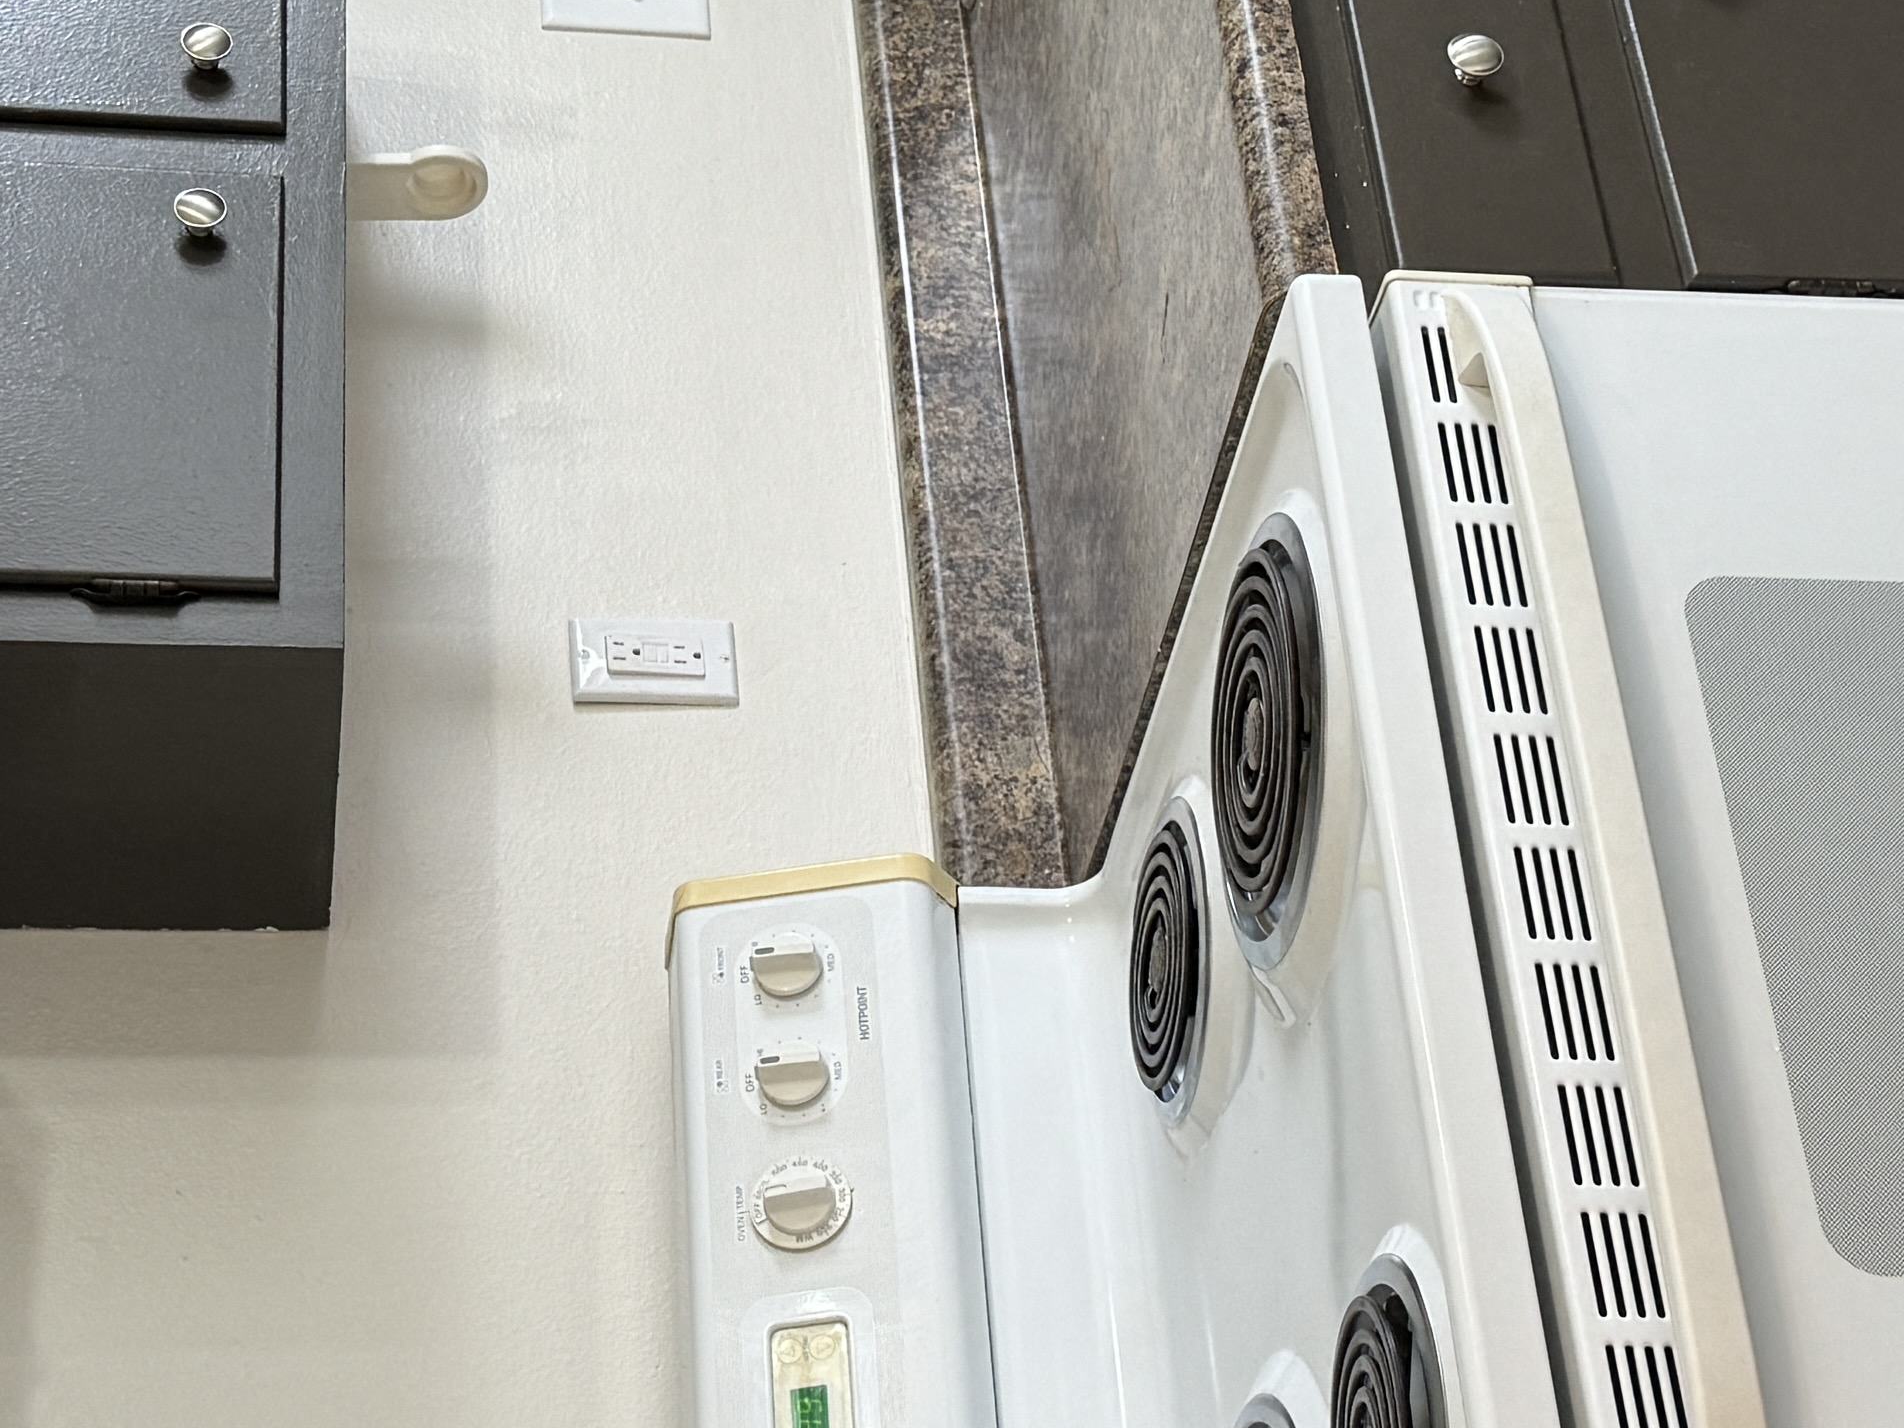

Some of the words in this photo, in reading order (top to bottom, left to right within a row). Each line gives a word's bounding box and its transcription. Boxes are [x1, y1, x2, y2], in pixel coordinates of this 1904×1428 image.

[740, 965, 750, 984] OFF
[856, 986, 870, 1040] HOTPOINT
[745, 1073, 755, 1092] OFF
